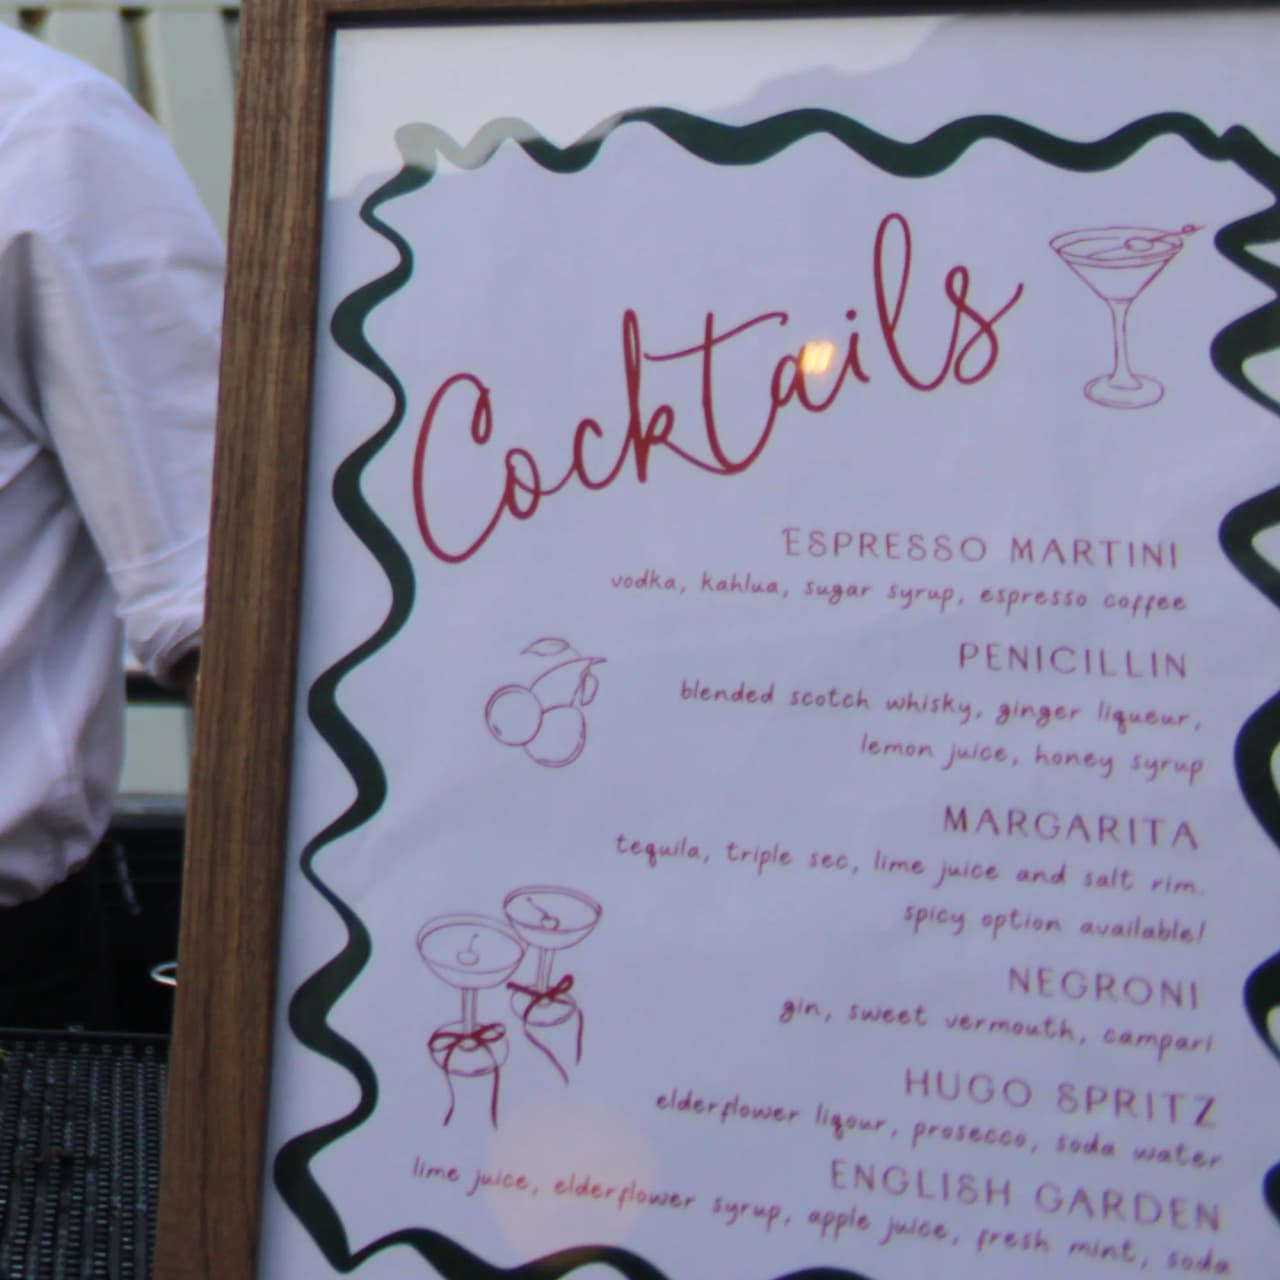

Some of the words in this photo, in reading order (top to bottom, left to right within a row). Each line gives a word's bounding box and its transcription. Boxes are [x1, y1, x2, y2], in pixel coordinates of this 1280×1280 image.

[413, 213, 1024, 563] Cocktails
[782, 527, 987, 562] ESPRESSO
[1011, 537, 1177, 569] MARTINI
[611, 568, 686, 595] vodka,
[701, 571, 789, 599] kahlua,
[804, 580, 871, 605] sugar
[888, 584, 964, 613] syrup,
[980, 586, 1087, 616] espresso
[1104, 592, 1187, 618] coffee
[959, 642, 1187, 679] PENICILLIN
[680, 679, 775, 704] blended
[790, 685, 870, 711] scotch
[885, 691, 982, 725] whisky,
[996, 701, 1081, 728] ginger
[1098, 699, 1201, 736] liqueur,
[860, 732, 933, 758] lemon
[944, 744, 1018, 770] juice,
[1035, 744, 1114, 778] honey
[1131, 753, 1203, 787] syrup
[944, 804, 1197, 850] MARGARITA
[616, 833, 709, 868] tequila,
[727, 842, 792, 876] triple
[809, 851, 858, 875] sec,
[874, 849, 925, 875] lime
[932, 861, 999, 888] juice
[1016, 863, 1067, 885] and
[1084, 867, 1134, 890] salt
[905, 904, 965, 936] spicy
[981, 908, 1061, 941] option
[1009, 965, 1199, 1010] NEGRONI
[778, 998, 831, 1024] gin,
[848, 1002, 928, 1025] sweet
[946, 1013, 1087, 1046] vermouth,
[1103, 1024, 1214, 1063] campari
[905, 1067, 1032, 1108] HUGO
[1056, 1082, 1216, 1128] SPRITZ
[656, 1087, 800, 1125] elderflower
[912, 1121, 1037, 1154] prosecco,
[1056, 1131, 1115, 1156] soda
[1133, 1143, 1223, 1168] water
[412, 1155, 460, 1182] lime
[466, 1170, 538, 1197] juice,
[554, 1173, 696, 1211] elderflower
[712, 1195, 791, 1232] syrup,
[808, 1205, 871, 1241] apple
[879, 1217, 960, 1246] juice,
[976, 1227, 1050, 1253] fresh
[1068, 1239, 1148, 1269] mint,
[831, 1158, 1012, 1208] ENGLISH
[1035, 1181, 1222, 1233] GARDEN
